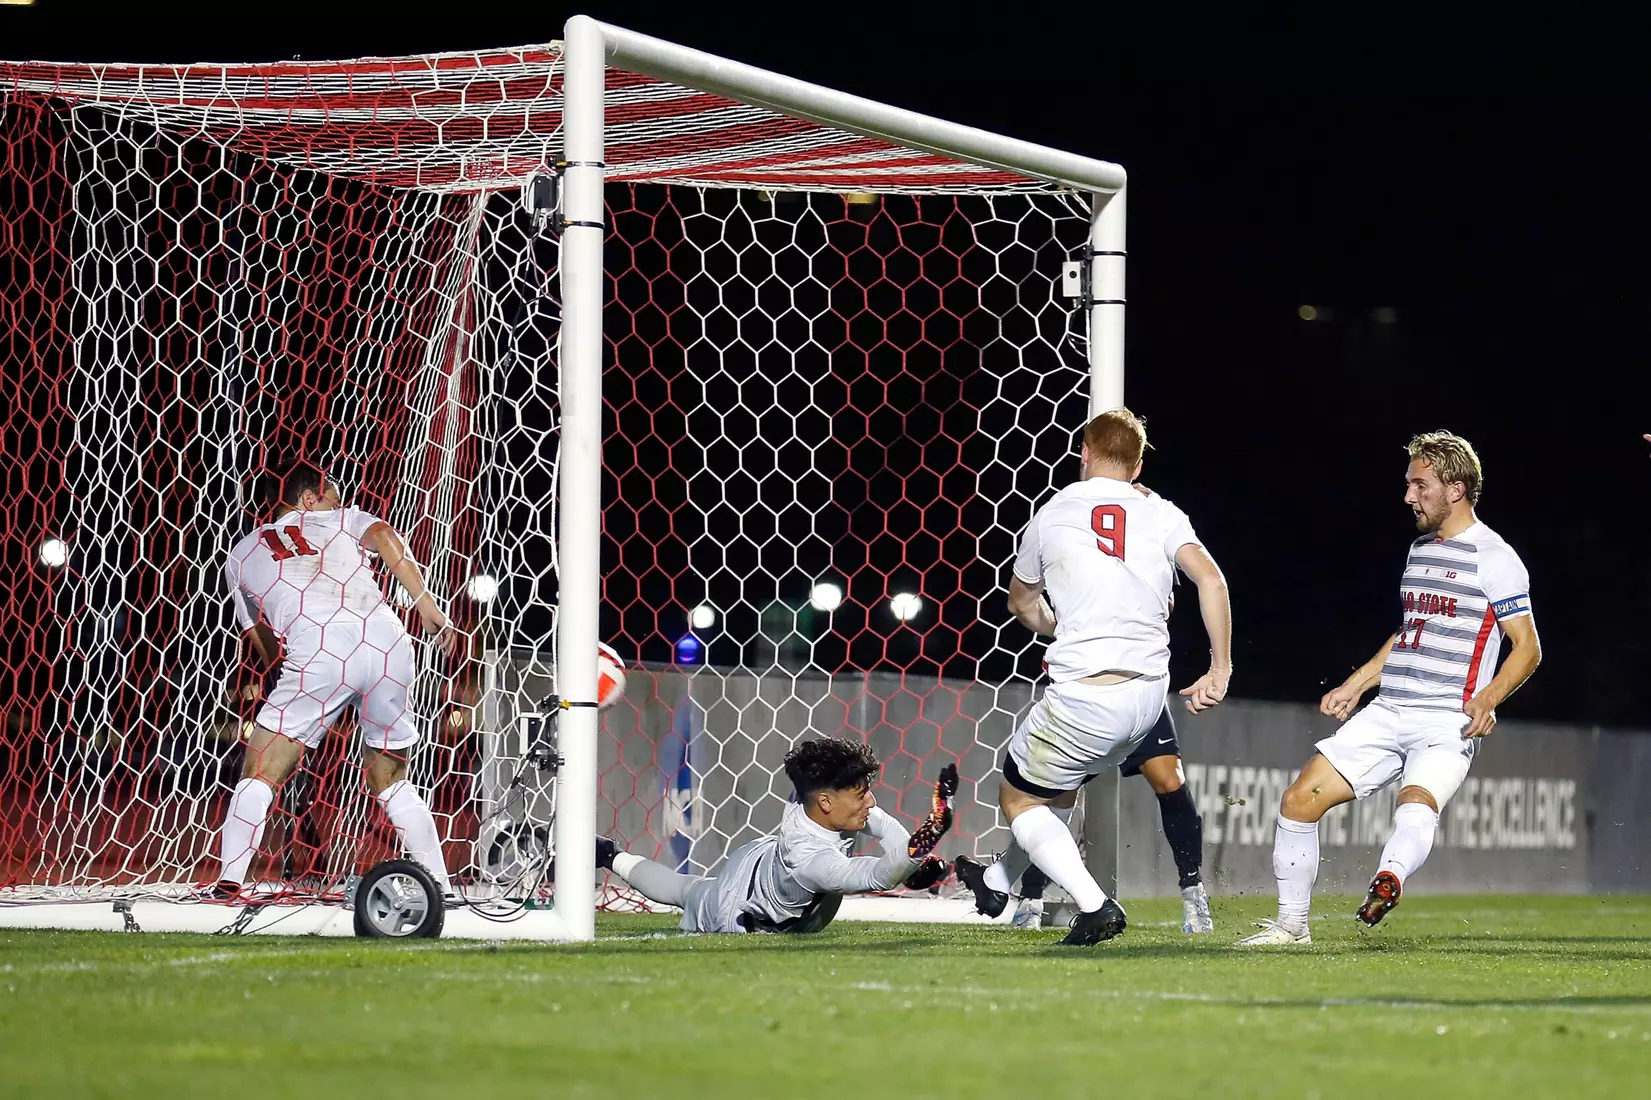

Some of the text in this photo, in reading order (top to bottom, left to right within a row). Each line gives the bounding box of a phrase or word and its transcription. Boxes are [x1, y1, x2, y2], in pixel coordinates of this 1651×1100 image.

[261, 525, 318, 562] 11
[1091, 504, 1126, 562] 9
[1417, 592, 1457, 618] STATE
[1398, 617, 1426, 649] 17
[1186, 763, 1227, 844] THE
[1226, 766, 1301, 846] PEOP
